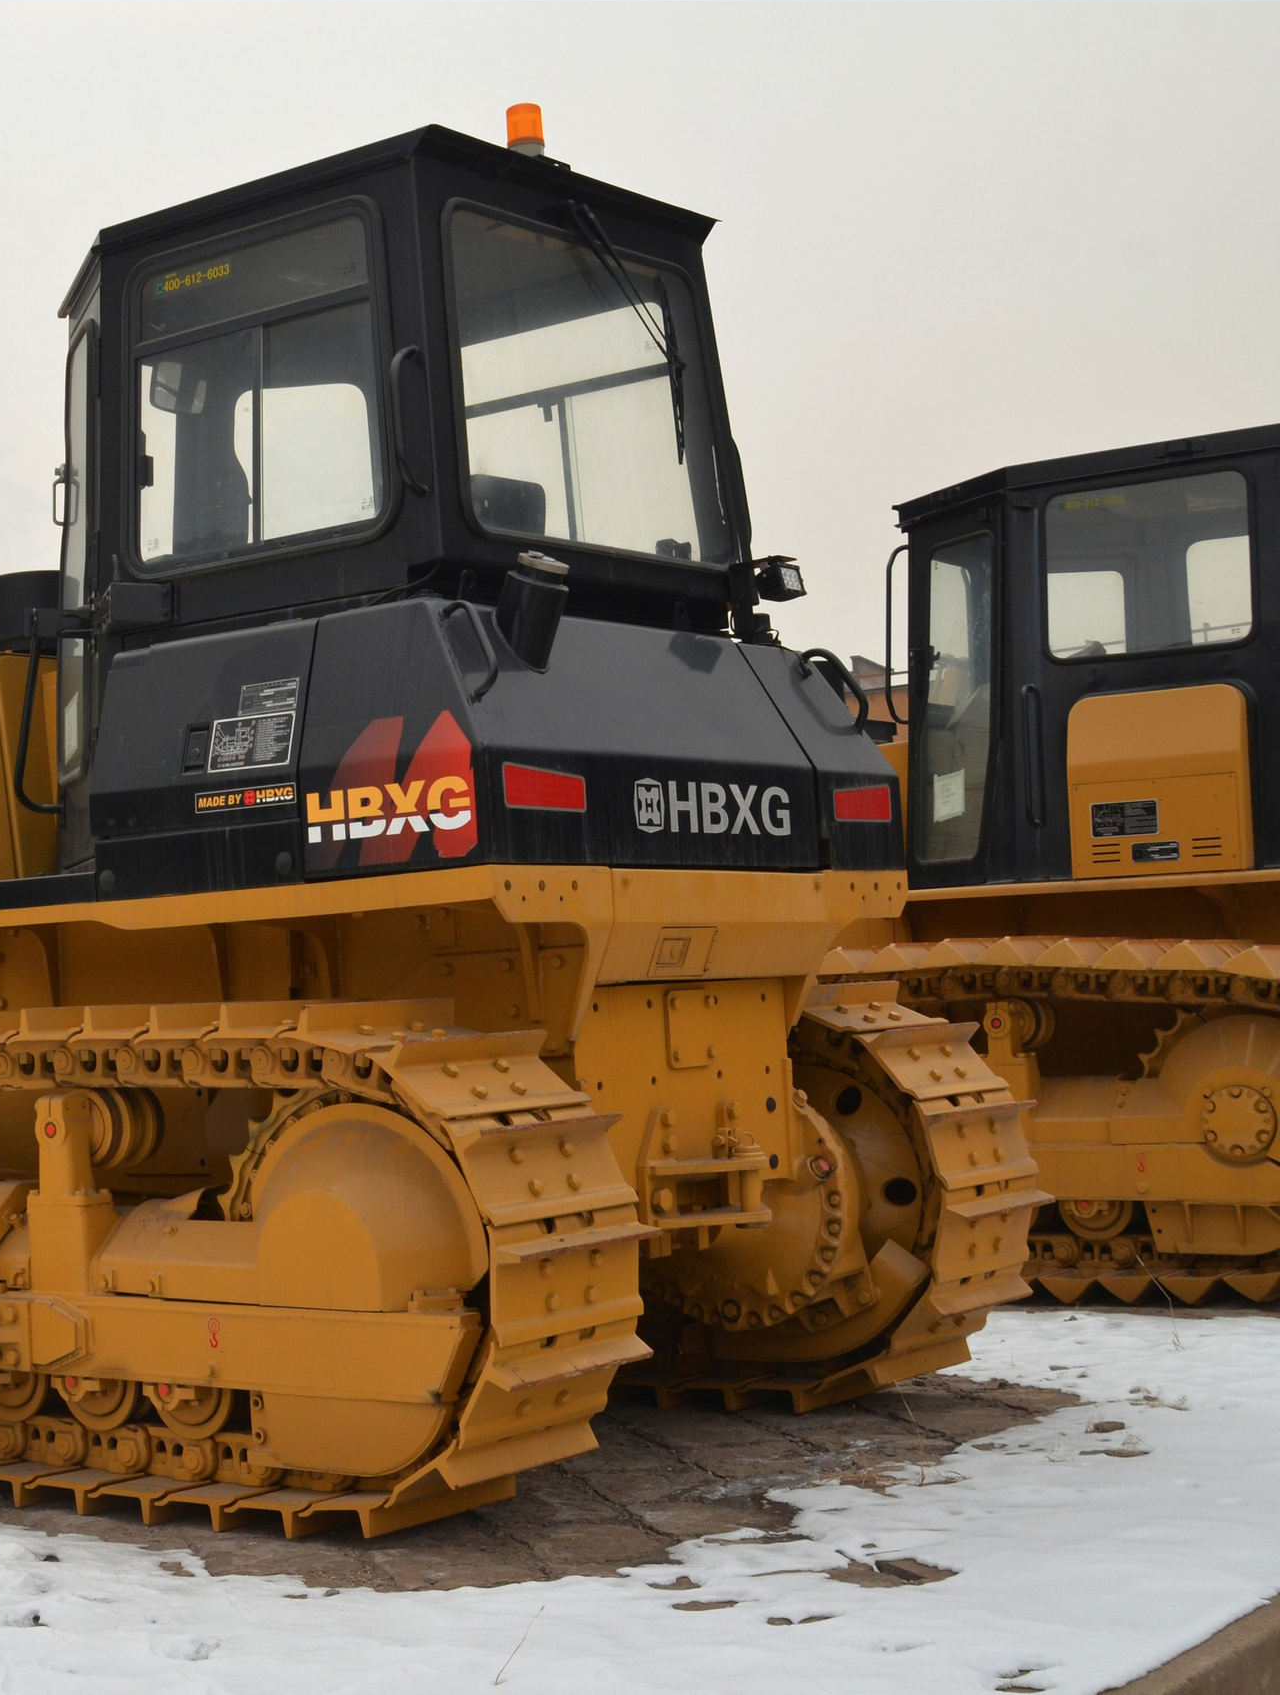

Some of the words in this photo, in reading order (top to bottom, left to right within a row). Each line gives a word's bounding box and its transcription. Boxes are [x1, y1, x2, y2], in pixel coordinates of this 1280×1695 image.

[163, 263, 230, 292] 400-612-6033
[198, 795, 226, 809] MADE
[227, 793, 242, 805] BY
[256, 786, 294, 804] HBXG
[306, 775, 472, 844] HBXG
[668, 780, 792, 837] HBXG
